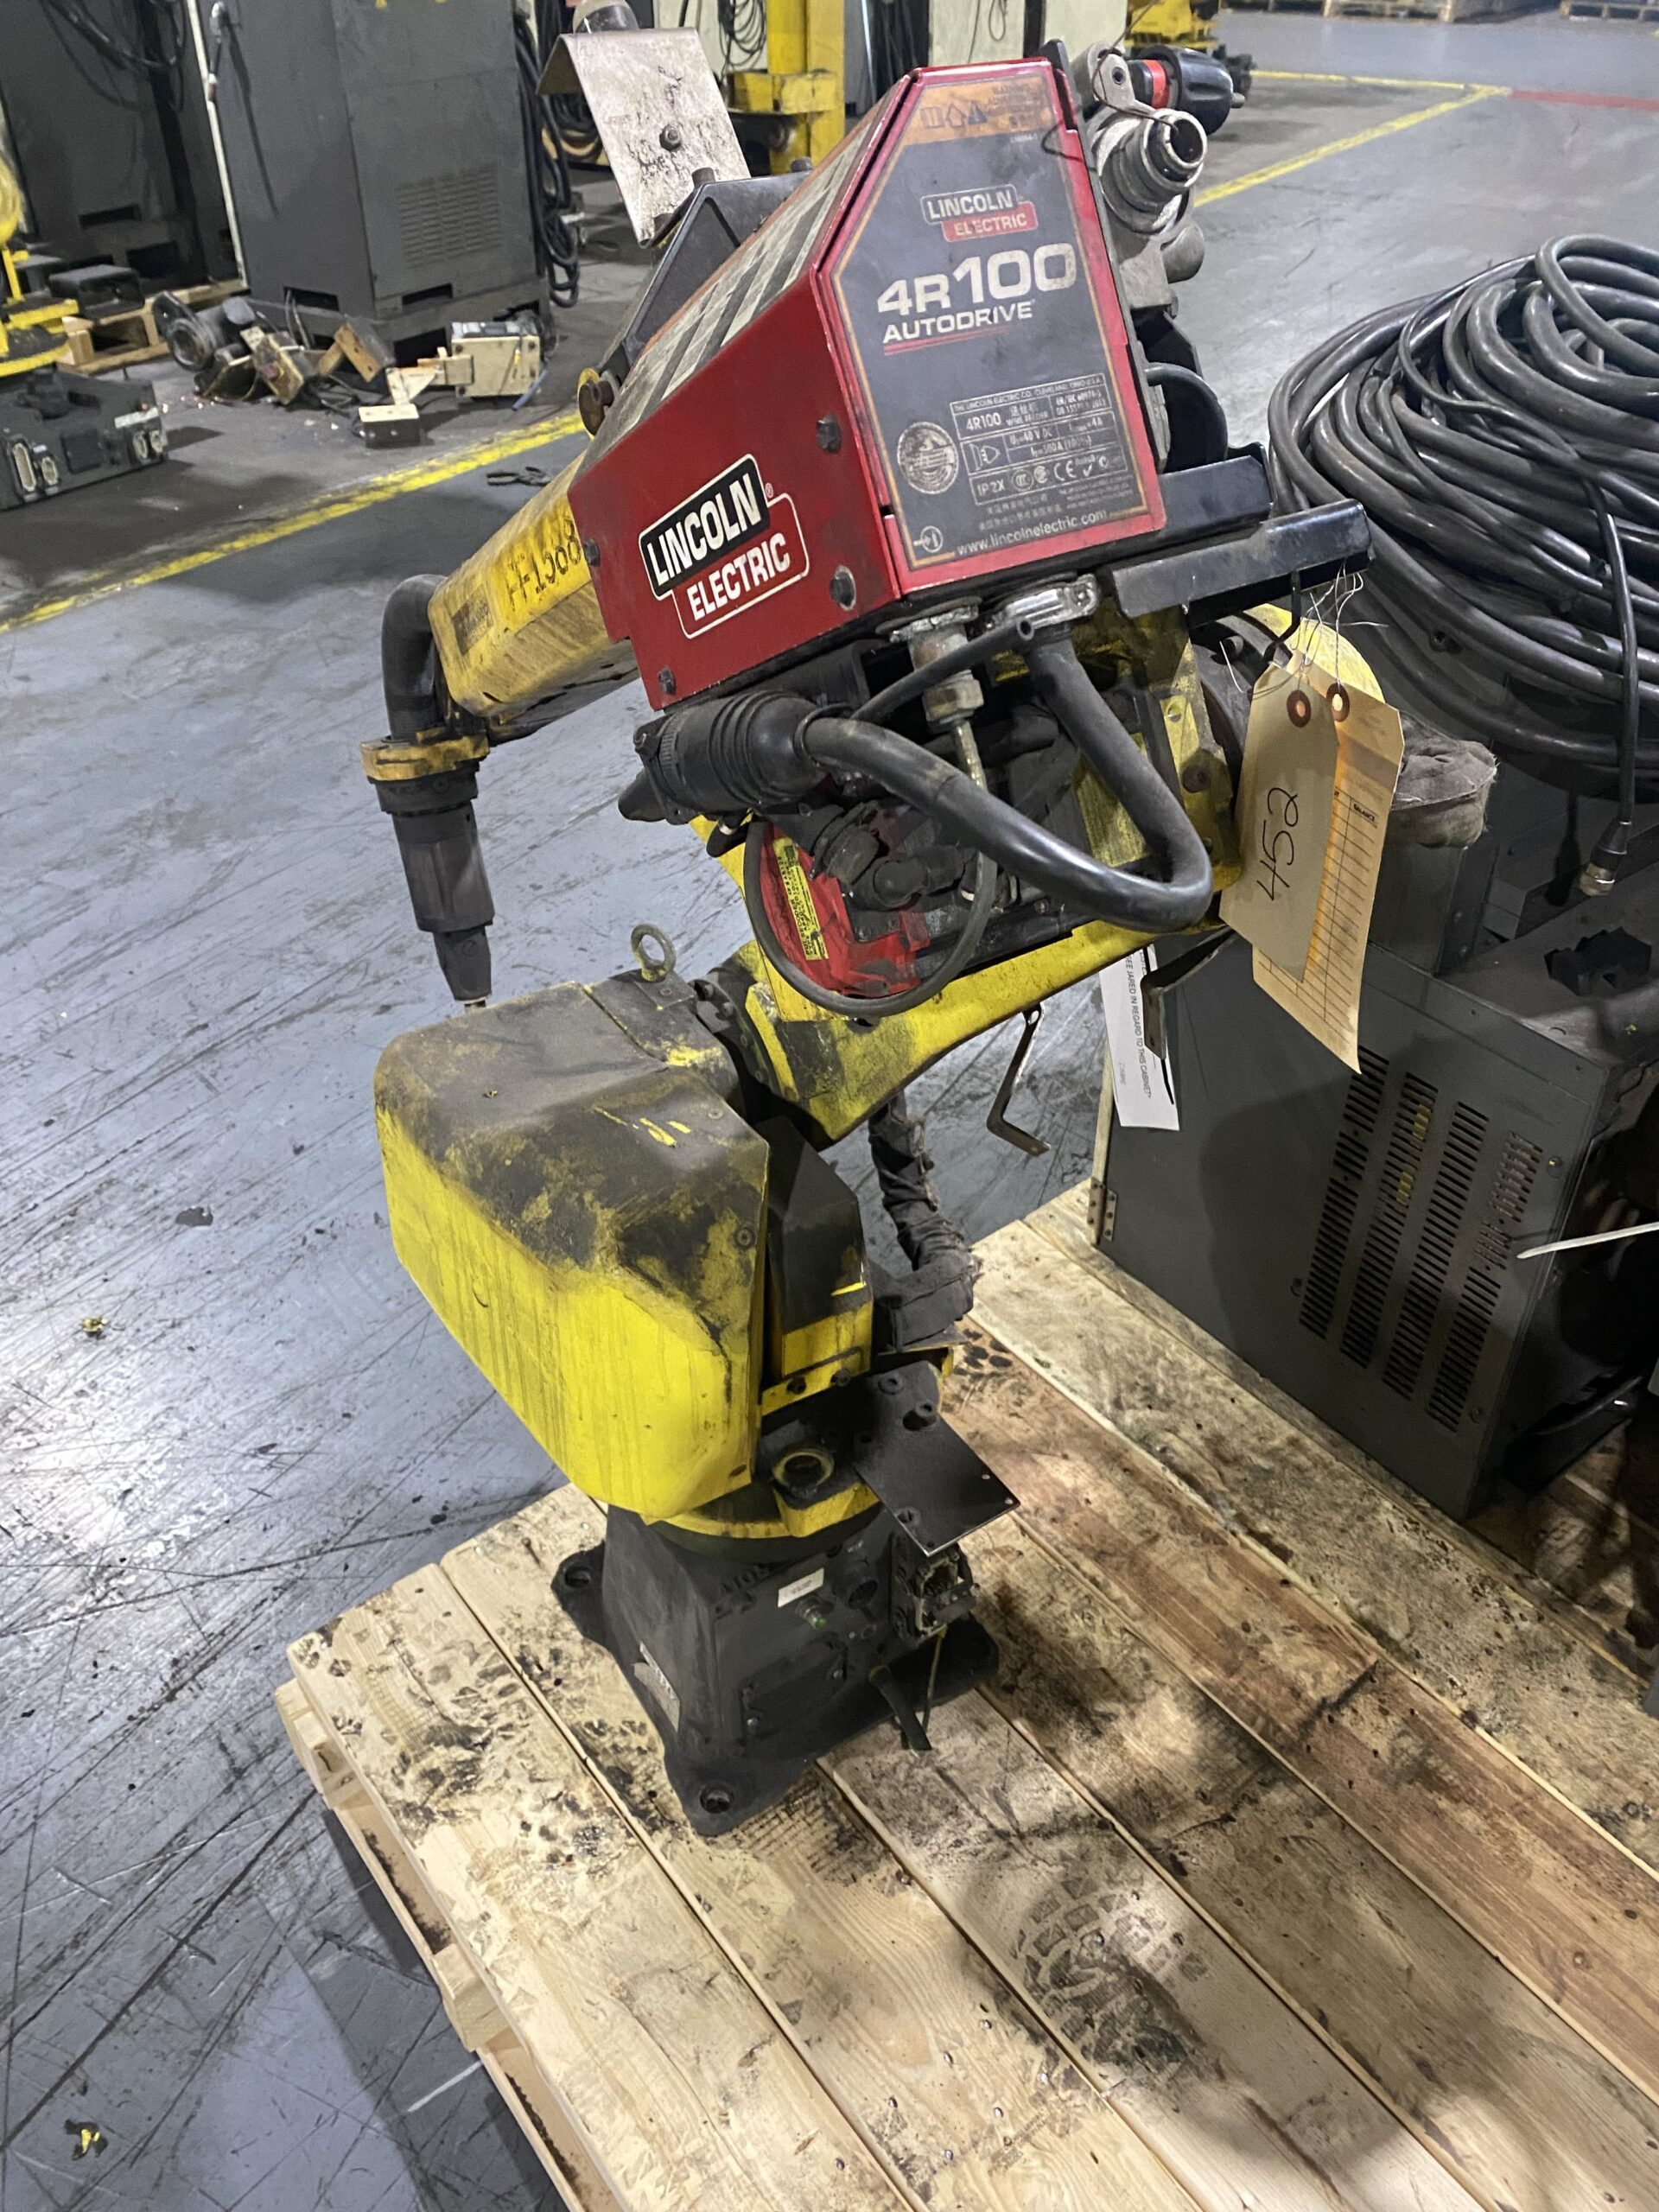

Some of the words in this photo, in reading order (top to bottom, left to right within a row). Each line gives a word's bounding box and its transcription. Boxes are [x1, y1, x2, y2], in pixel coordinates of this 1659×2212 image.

[926, 189, 1014, 219] LINCOLN
[954, 213, 1027, 237] ELECTRIC
[876, 242, 1077, 316] 4R100
[881, 300, 1033, 344] AUTODRIVE
[964, 411, 1001, 431] 4R100
[646, 473, 762, 587] LINCOLN
[957, 509, 1108, 556] www.lincolnelectric.com
[687, 532, 790, 621] ELECTRIC
[1256, 787, 1299, 901] 452
[1126, 969, 1136, 994] JARED
[1131, 1005, 1142, 1035] REGARD
[1135, 1036, 1143, 1046] TO
[1136, 1048, 1146, 1064] THIS
